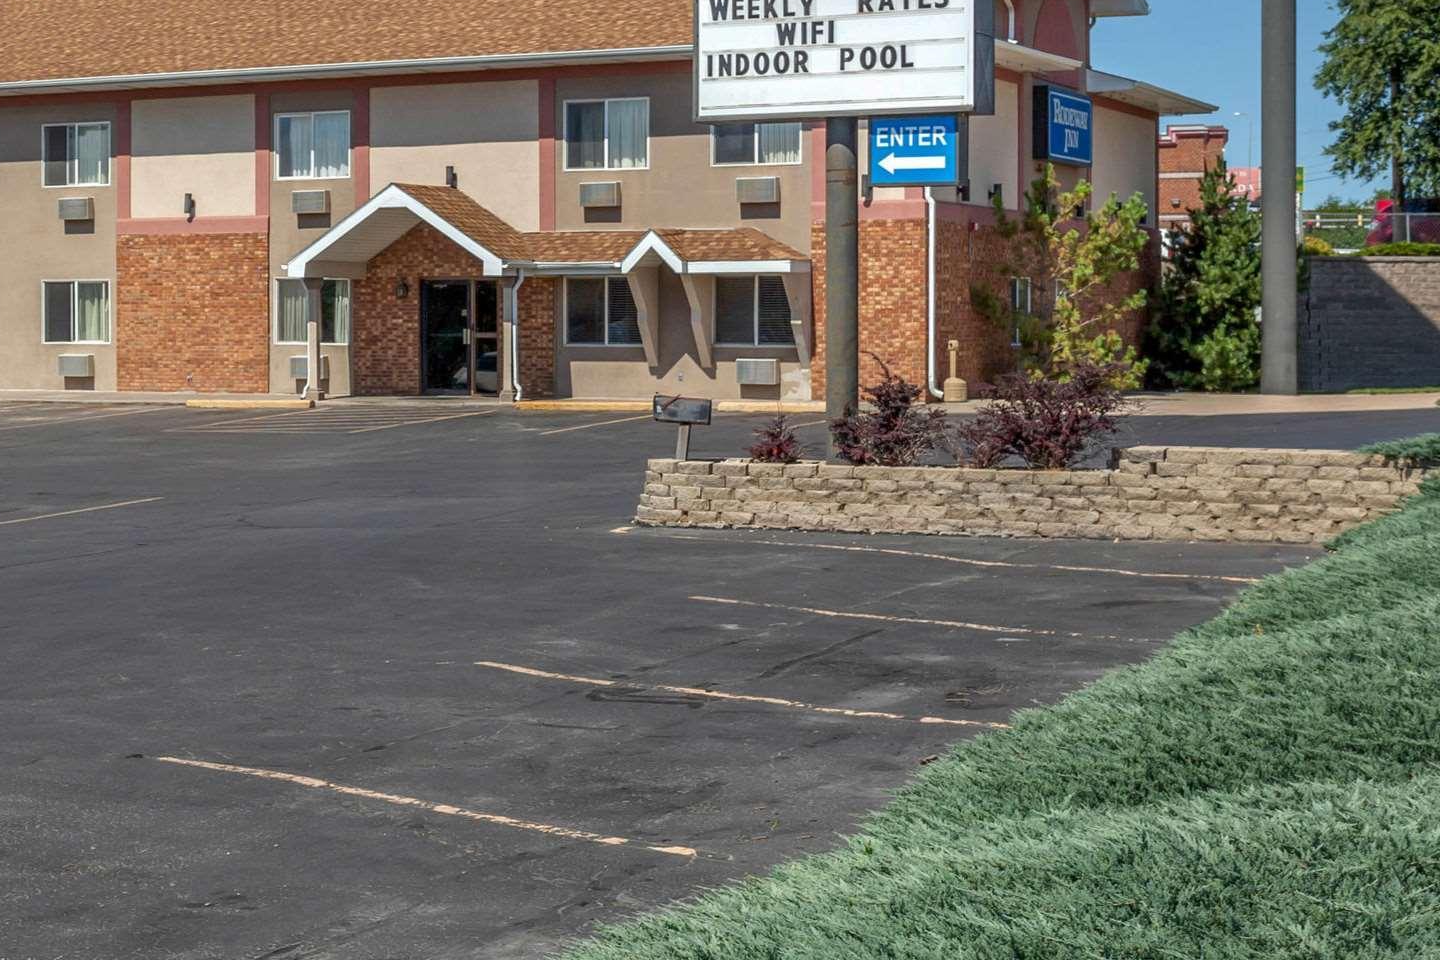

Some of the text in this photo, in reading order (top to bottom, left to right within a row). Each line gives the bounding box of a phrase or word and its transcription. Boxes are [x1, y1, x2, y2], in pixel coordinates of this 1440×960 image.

[776, 20, 835, 46] WIFI
[707, 45, 914, 77] INDOOR POOL
[1053, 98, 1089, 130] RODEWAY
[876, 126, 948, 147] ENTER
[1064, 128, 1079, 152] INN
